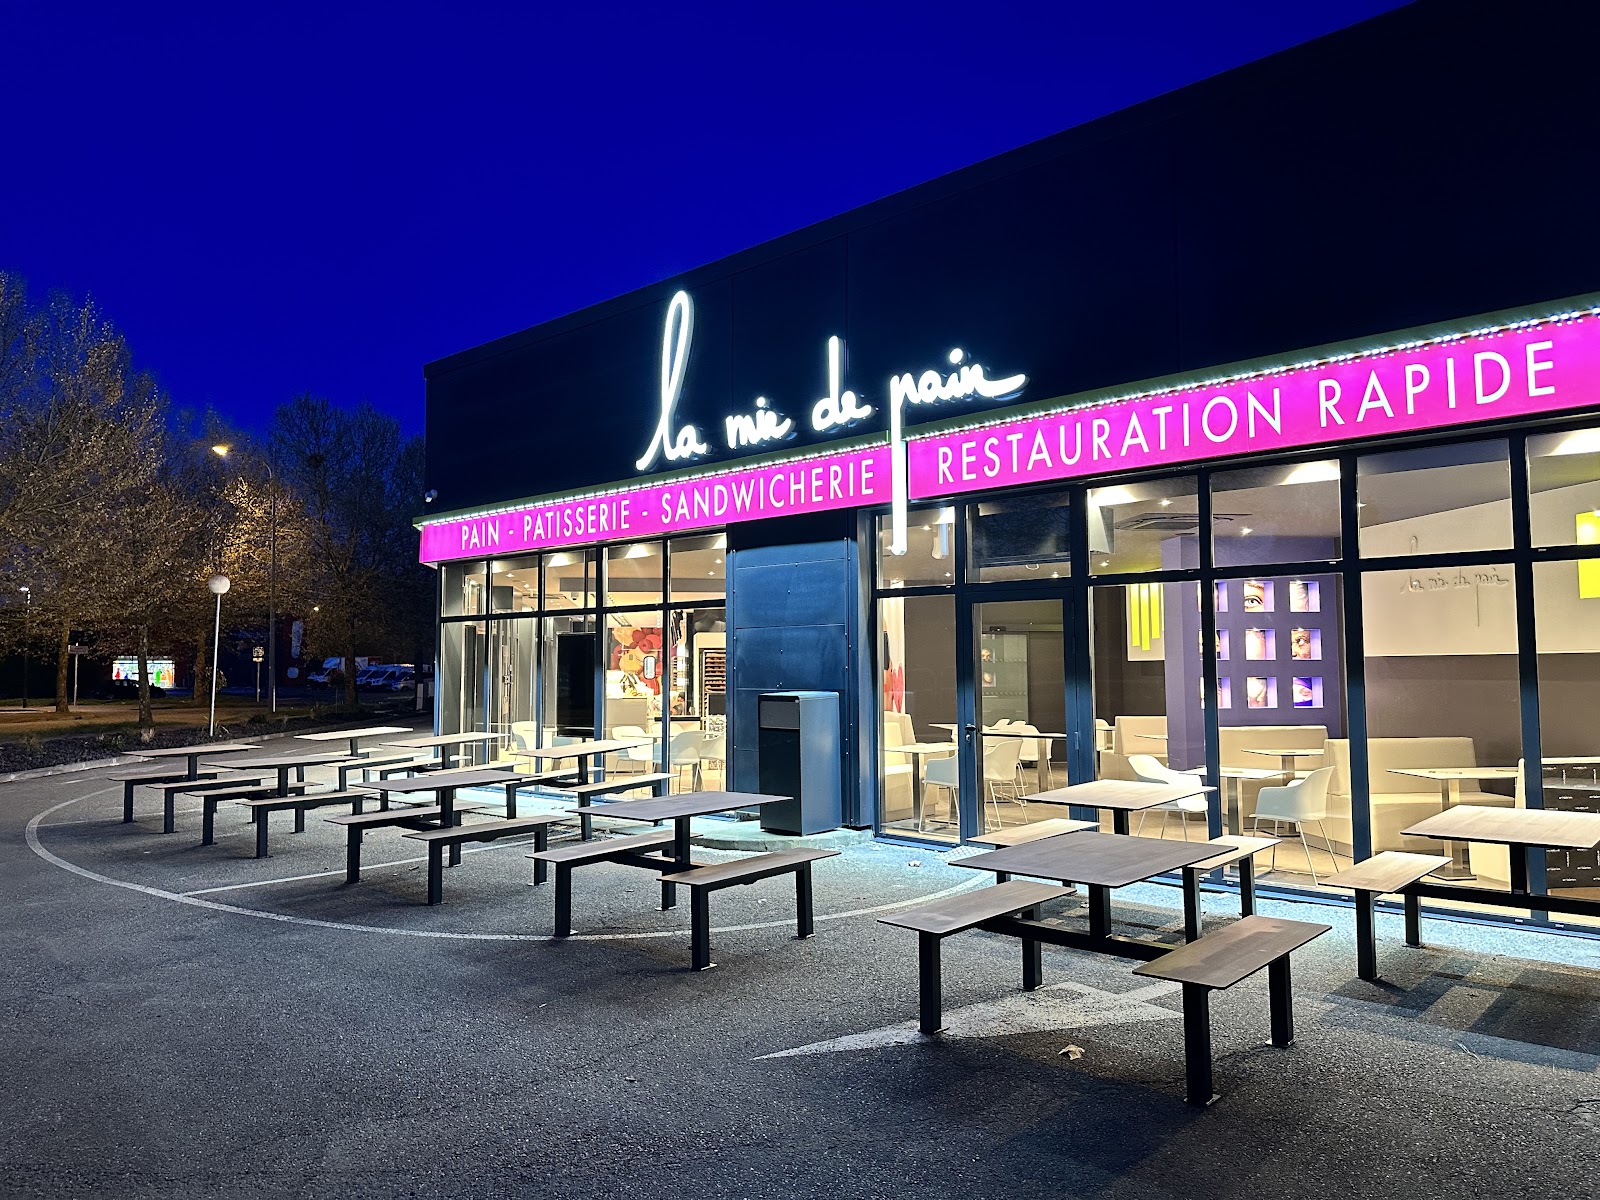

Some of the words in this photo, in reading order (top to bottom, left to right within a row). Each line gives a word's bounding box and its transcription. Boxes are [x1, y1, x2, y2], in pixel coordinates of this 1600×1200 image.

[635, 290, 707, 472] la
[725, 396, 792, 449] mie
[811, 335, 872, 431] de
[889, 347, 1027, 556] pain
[937, 390, 1282, 485] RESTAURATION
[1319, 340, 1556, 428] RAPIDE
[461, 519, 500, 550] PAIN
[523, 500, 631, 541] PATISSERIE
[660, 458, 876, 524] SANDWICHERIE
